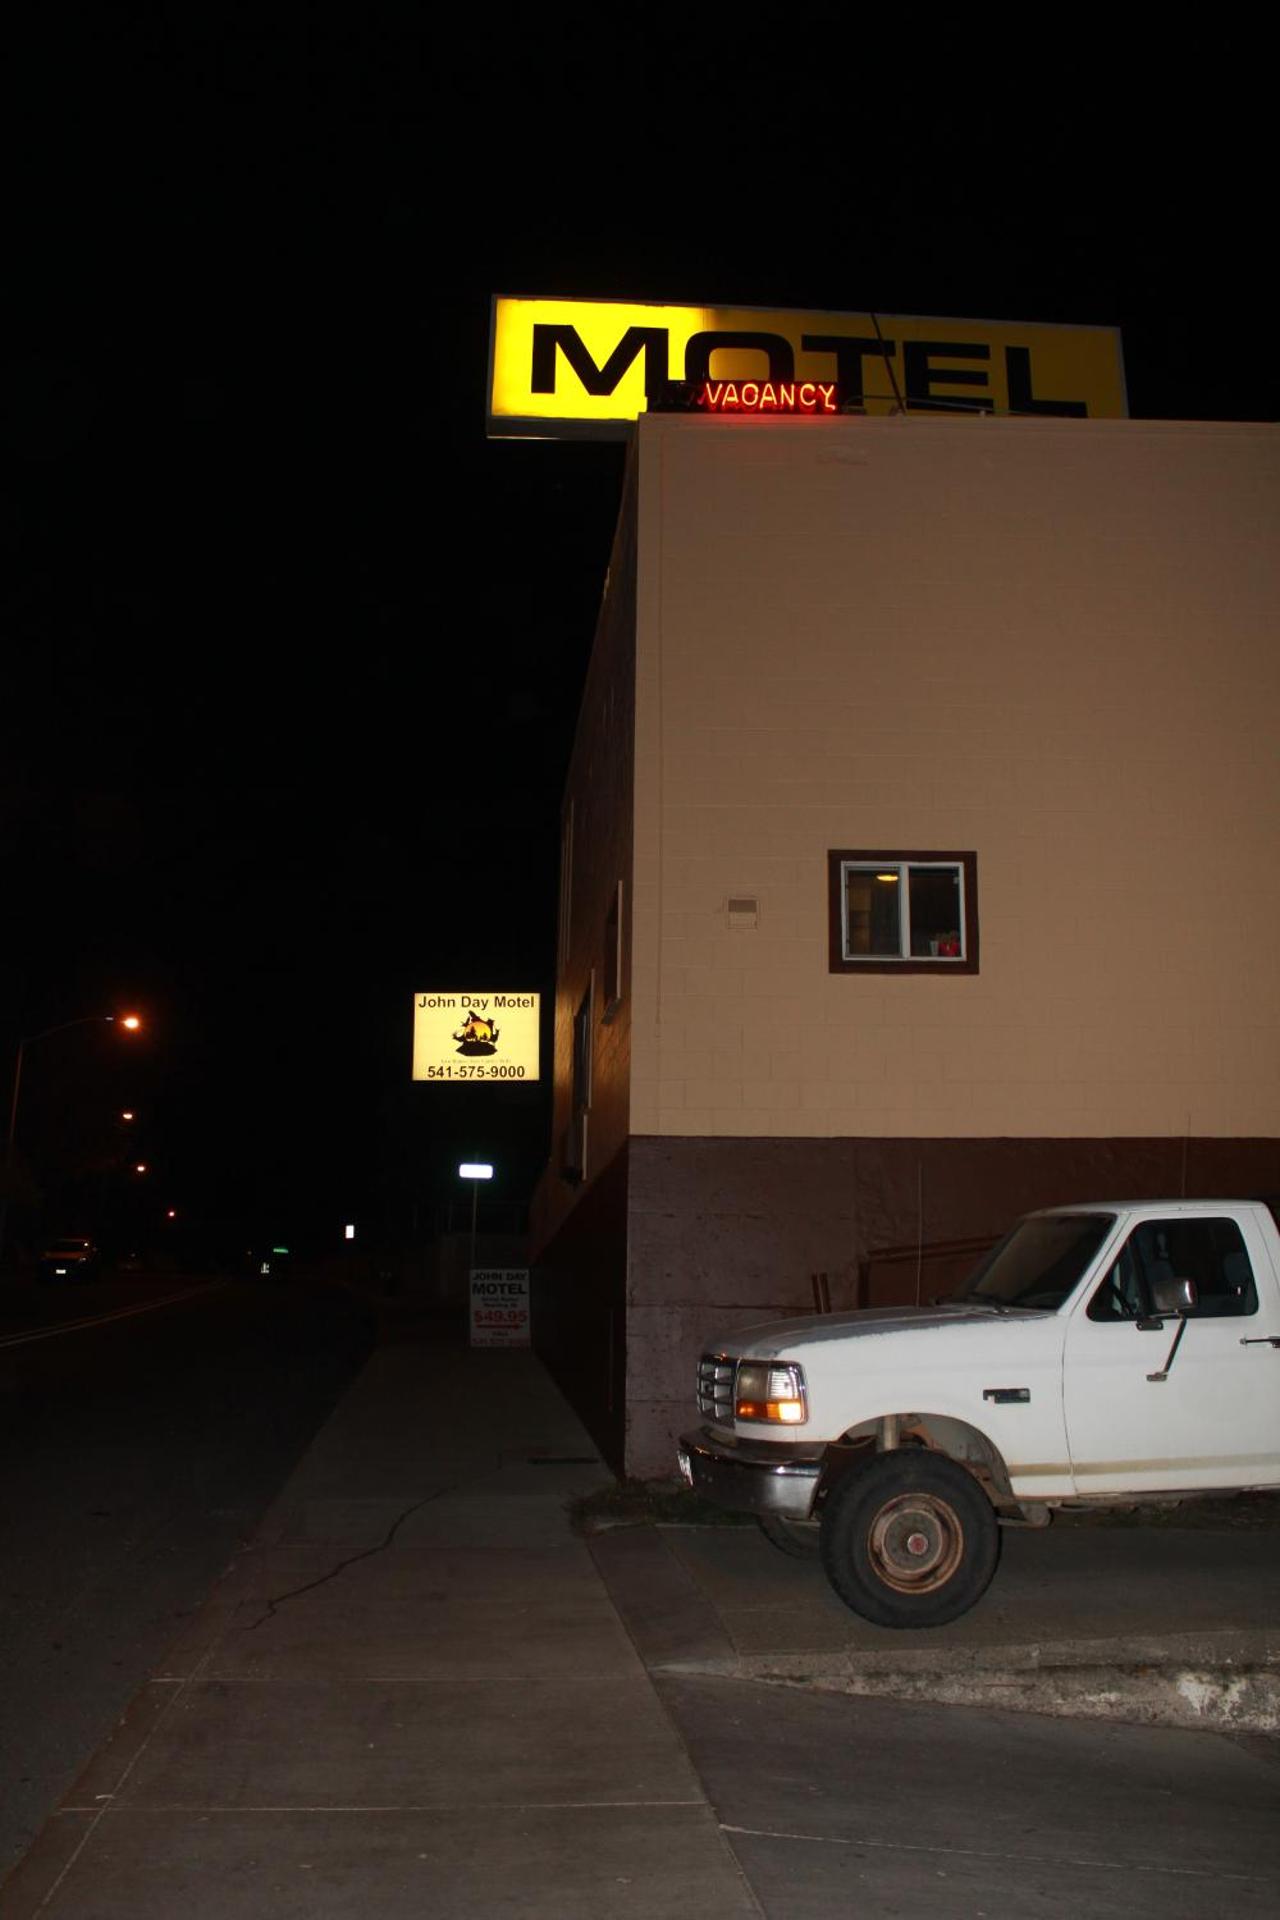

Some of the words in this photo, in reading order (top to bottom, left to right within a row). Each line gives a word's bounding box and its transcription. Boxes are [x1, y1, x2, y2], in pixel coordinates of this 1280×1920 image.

[531, 323, 1087, 418] MOTEL
[418, 996, 456, 1008] John
[461, 996, 489, 1010] Day
[494, 996, 535, 1008] Motel
[427, 1066, 525, 1078] 541-575-9000
[473, 1272, 502, 1280] JOHN
[506, 1272, 527, 1280] DAY
[472, 1283, 527, 1295] MOTEL
